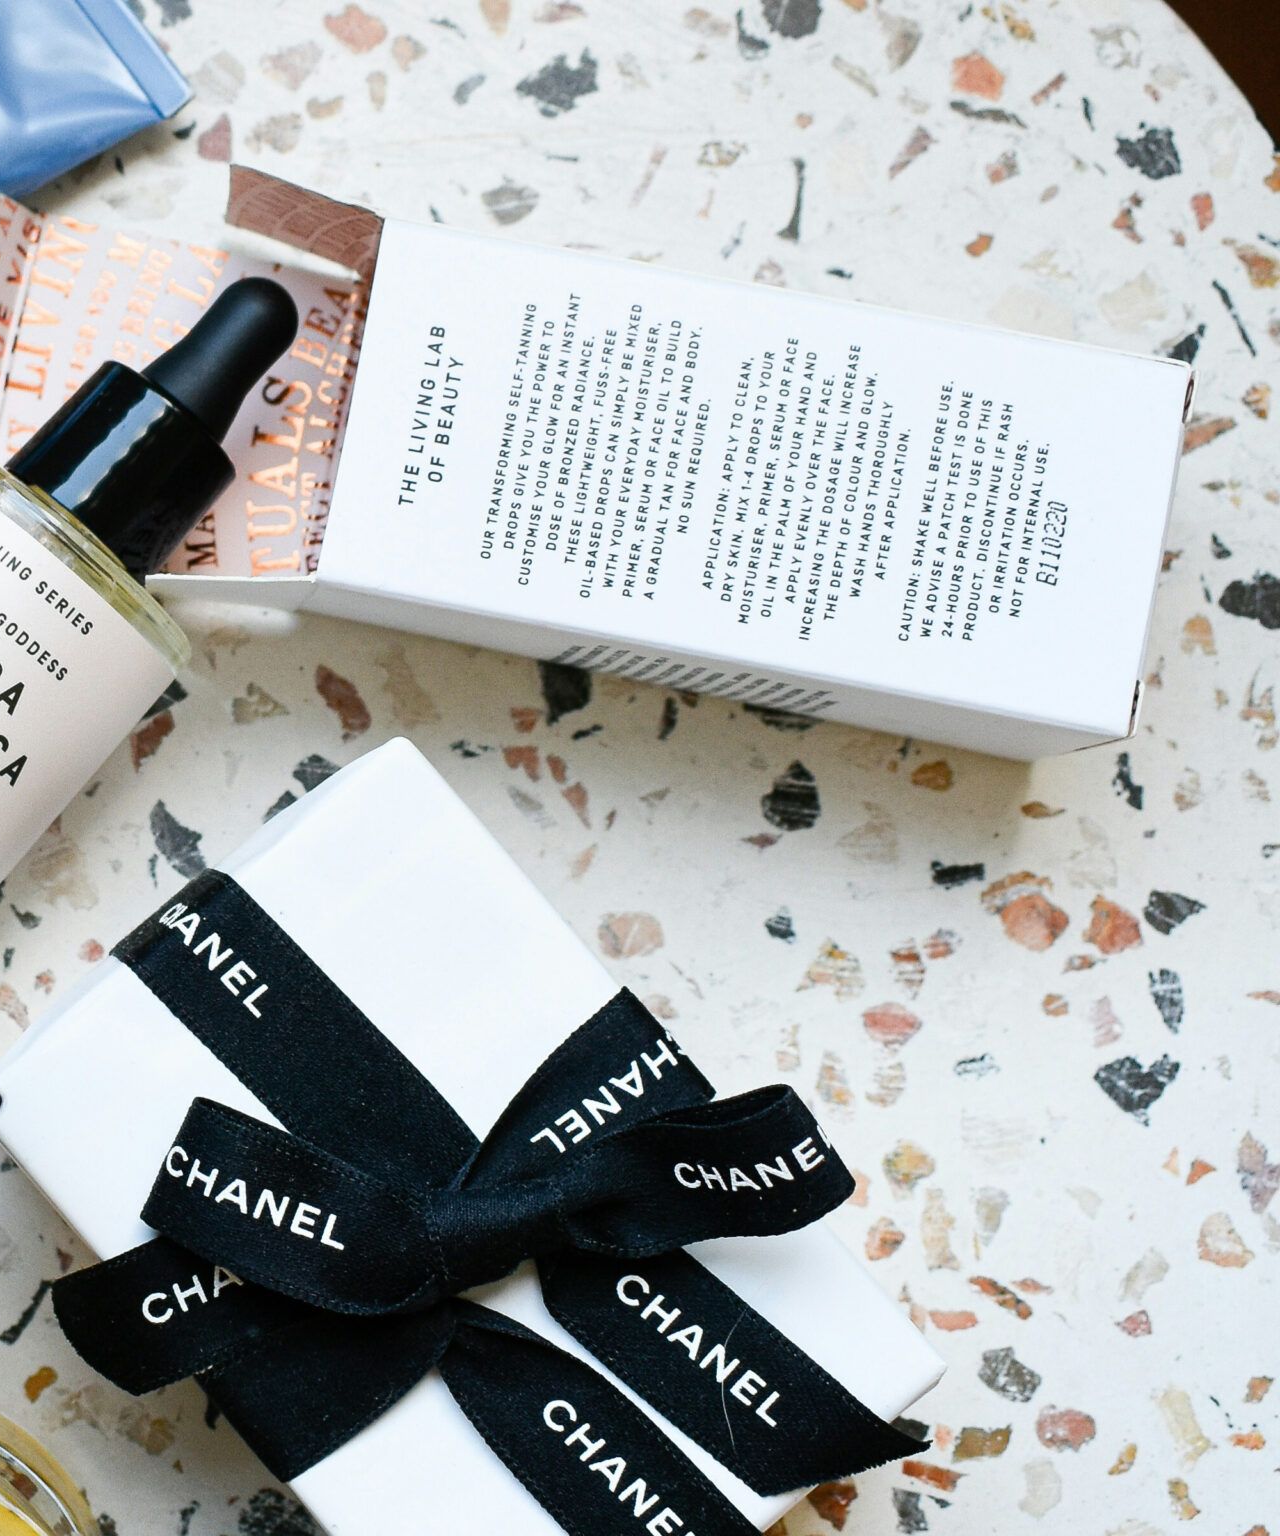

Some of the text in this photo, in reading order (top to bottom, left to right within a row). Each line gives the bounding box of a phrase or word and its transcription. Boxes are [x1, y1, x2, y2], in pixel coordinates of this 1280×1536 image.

[664, 319, 682, 362] BUILD
[782, 337, 799, 373] FACE
[660, 366, 674, 384] TO
[758, 350, 775, 388] YOUR
[778, 378, 792, 397] OR
[397, 325, 445, 506] THE LIVING LAB
[426, 356, 464, 483] OF BEAUTY
[655, 390, 670, 412] OIL
[729, 412, 743, 429] TO
[754, 394, 768, 411] TO
[996, 402, 1013, 442] RASH
[479, 303, 537, 560] OUR TRANSFORMING SELF-TANNING
[502, 320, 555, 550] DROPS GIVE YOU THE POWER TO
[517, 292, 581, 586] CUSTOMISE YOUR GLOW FOR AN INSTANT
[563, 518, 583, 564] THESE
[592, 329, 617, 407] FUSS-FREE
[578, 303, 642, 598] OIL-BASED DROPS CAN SIMPLY BE MIXED
[647, 416, 665, 454] FACE
[744, 417, 764, 465] DROPS
[768, 402, 787, 451] SERUM
[811, 419, 827, 446] THE
[854, 420, 869, 451] AND
[927, 416, 948, 472] BEFORE
[556, 417, 580, 485] BRONZED
[617, 425, 642, 503] EVERYDAY
[643, 458, 657, 478] OR
[721, 434, 739, 482] APPLY
[804, 451, 821, 490] OVER
[993, 445, 1005, 460] IF
[552, 490, 566, 509] OF
[680, 479, 696, 509] SUN
[740, 470, 754, 490] 1-4
[797, 344, 861, 641] INCREASING THE DOSAGE WILL INCREASE
[842, 455, 863, 512] COLOUR
[848, 400, 893, 597] WASH HANDS THOROUGHLY
[920, 477, 938, 513] WELL
[608, 508, 627, 547] YOUR
[633, 482, 653, 532] SERUM
[675, 514, 690, 534] NO
[734, 496, 750, 523] MIX
[792, 494, 813, 551] EVENLY
[838, 517, 852, 535] OF
[919, 390, 973, 637] WE ADVISE A PATCH TEST IS DONE
[940, 399, 993, 638] 24-HOURS PRIOR TO USE OF THIS
[975, 464, 1004, 562] DISCONTINUE
[1020, 480, 1043, 551] INTERNAL
[544, 513, 562, 551] DOSE
[910, 518, 930, 567] SHAKE
[992, 505, 1017, 589] IRRITATION
[1036, 501, 1068, 586] B110220
[601, 552, 619, 588] WITH
[783, 555, 802, 604] APPLY
[828, 540, 848, 588] DEPTH
[873, 533, 892, 580] AFTER
[1014, 555, 1030, 584] FOR
[35, 580, 94, 636] SERIES
[719, 571, 735, 602] DRY
[822, 593, 839, 620] THE
[987, 593, 1002, 613] OR
[1008, 587, 1024, 618] NOT
[529, 1027, 688, 1154] HANEL
[164, 1145, 346, 1251] CHANEL
[616, 1274, 780, 1428] CHANEL
[542, 1399, 696, 1536] CHANE
